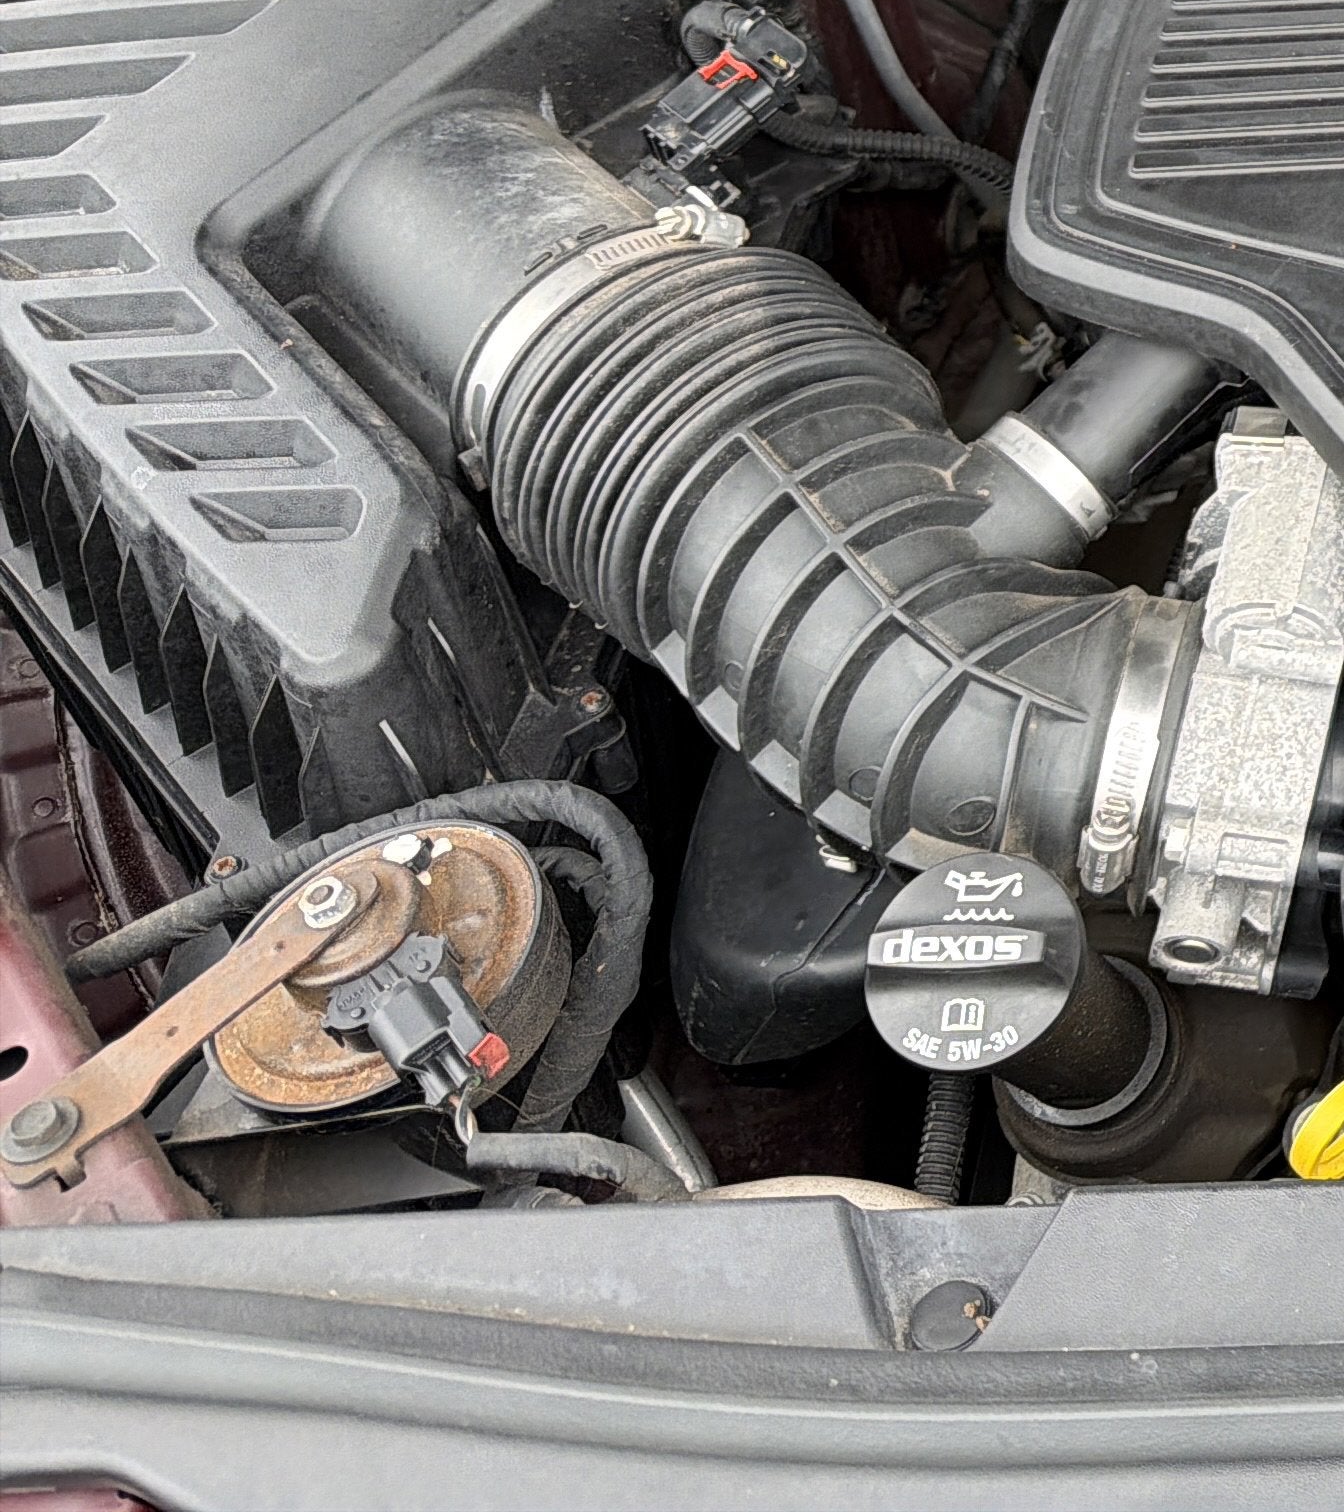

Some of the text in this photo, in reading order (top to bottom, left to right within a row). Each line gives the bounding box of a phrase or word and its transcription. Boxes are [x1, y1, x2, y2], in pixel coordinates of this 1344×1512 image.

[882, 928, 1029, 963] dexos
[902, 1025, 1019, 1061] SAE 5W-30
